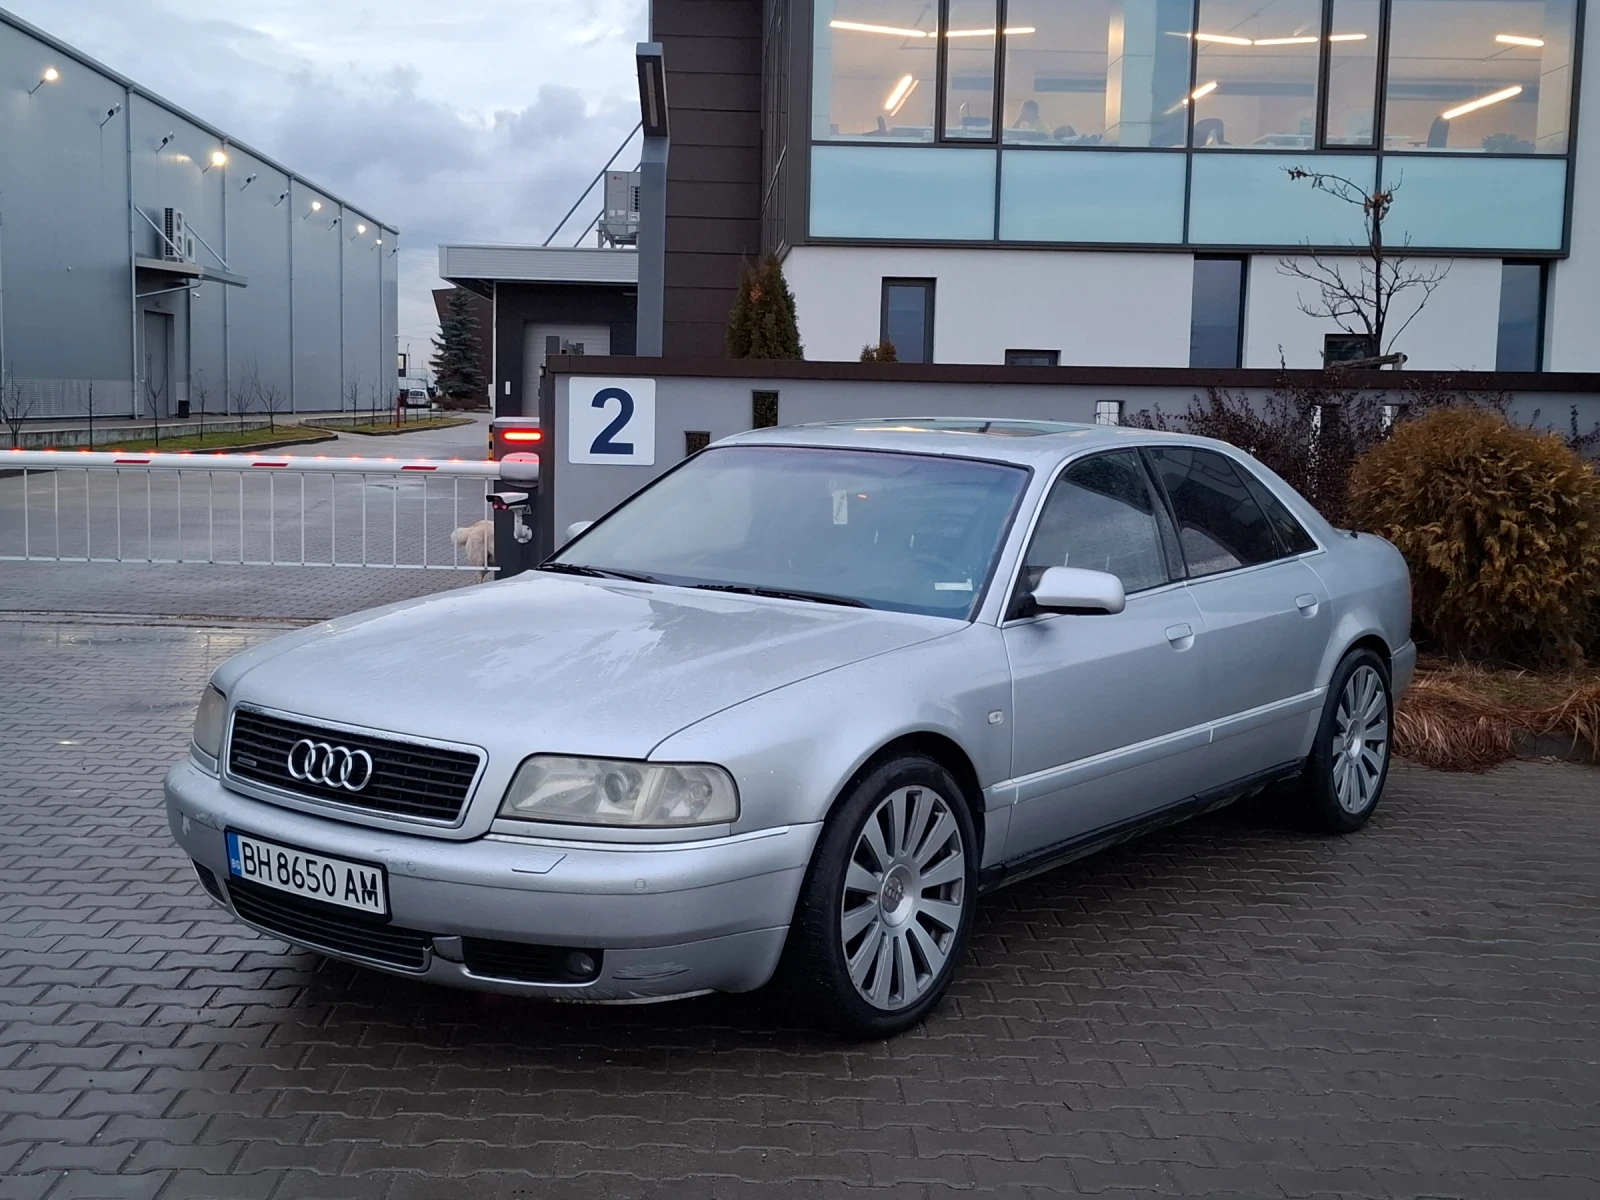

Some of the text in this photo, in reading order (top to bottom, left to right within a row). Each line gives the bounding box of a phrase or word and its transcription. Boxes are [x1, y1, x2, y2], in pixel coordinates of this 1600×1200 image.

[589, 387, 635, 455] 2
[231, 858, 241, 870] BG
[241, 841, 379, 908] BH 8650 AM
